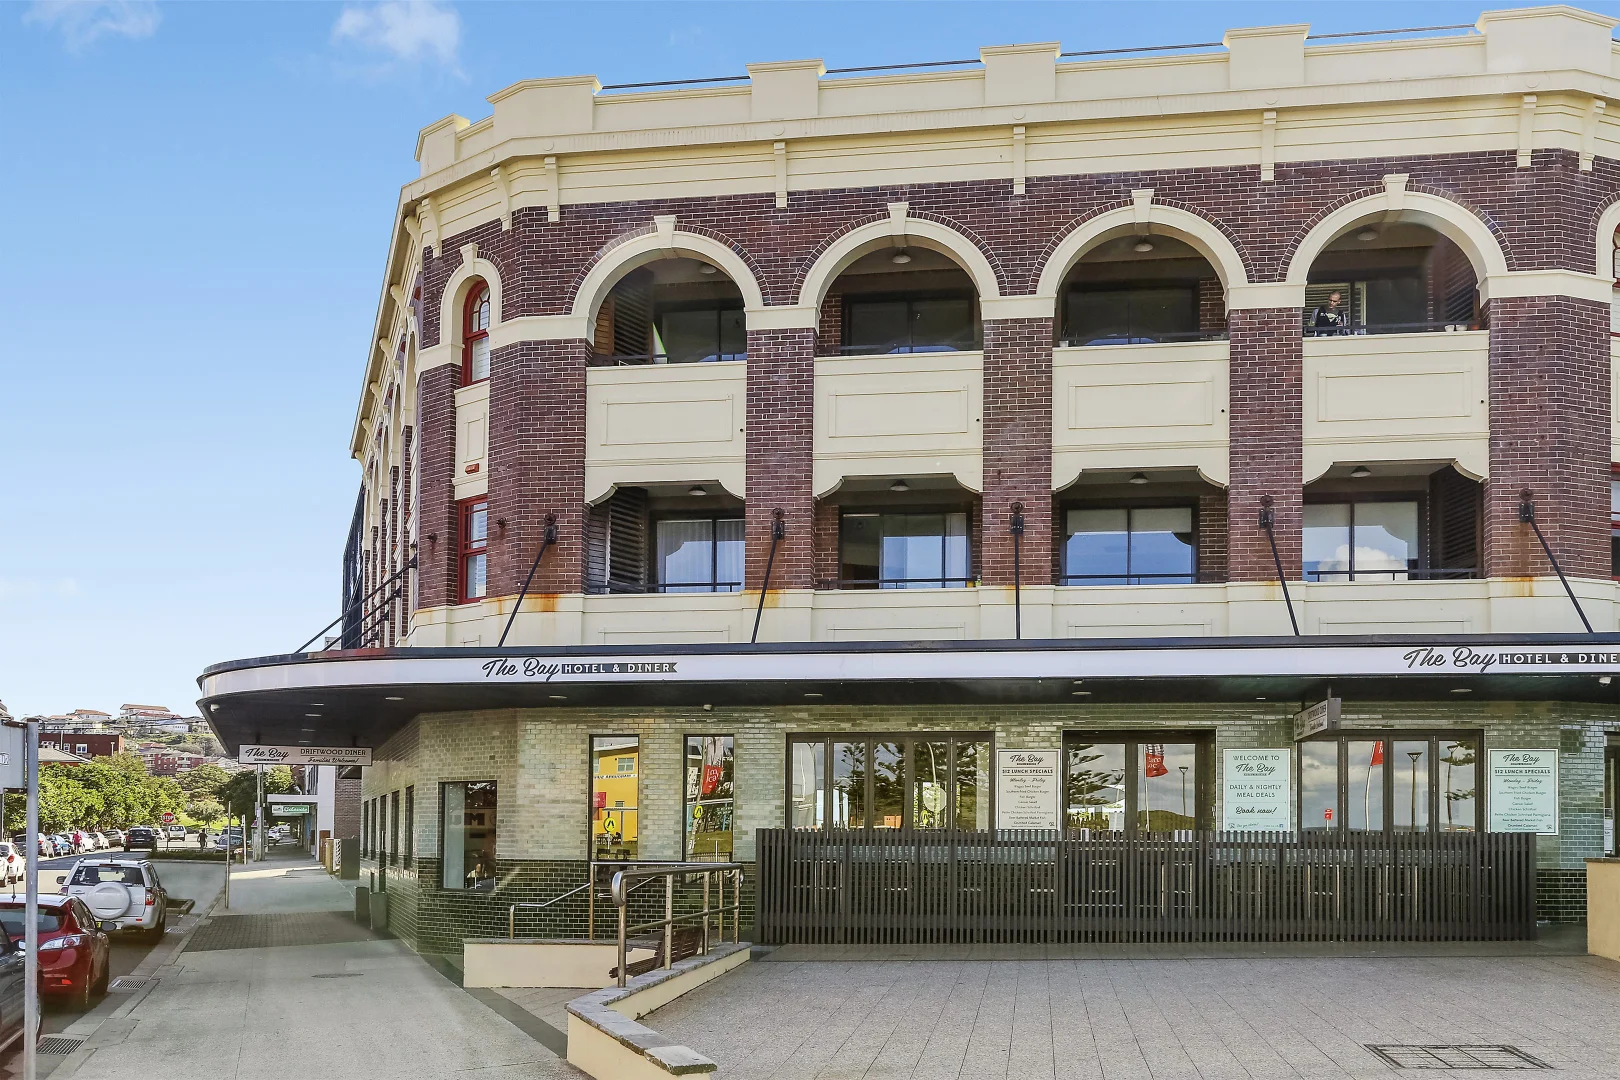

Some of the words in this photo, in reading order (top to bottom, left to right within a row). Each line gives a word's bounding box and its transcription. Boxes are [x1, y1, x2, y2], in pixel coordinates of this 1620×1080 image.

[1403, 647, 1446, 668] The
[1452, 646, 1496, 673] Bay
[1502, 654, 1552, 664] HOTEL
[1560, 654, 1569, 663] &
[482, 658, 518, 678] The
[523, 658, 560, 682] Bay
[564, 664, 606, 673] HOTEL
[612, 664, 620, 673] &
[628, 663, 670, 672] DINER
[245, 748, 266, 758] The
[268, 748, 289, 760] Bay
[1010, 755, 1025, 763] The
[1027, 754, 1044, 765] Bay
[1503, 754, 1520, 762] The
[1523, 754, 1540, 764] Bay
[1236, 763, 1254, 772] The
[1257, 763, 1276, 775] Bay
